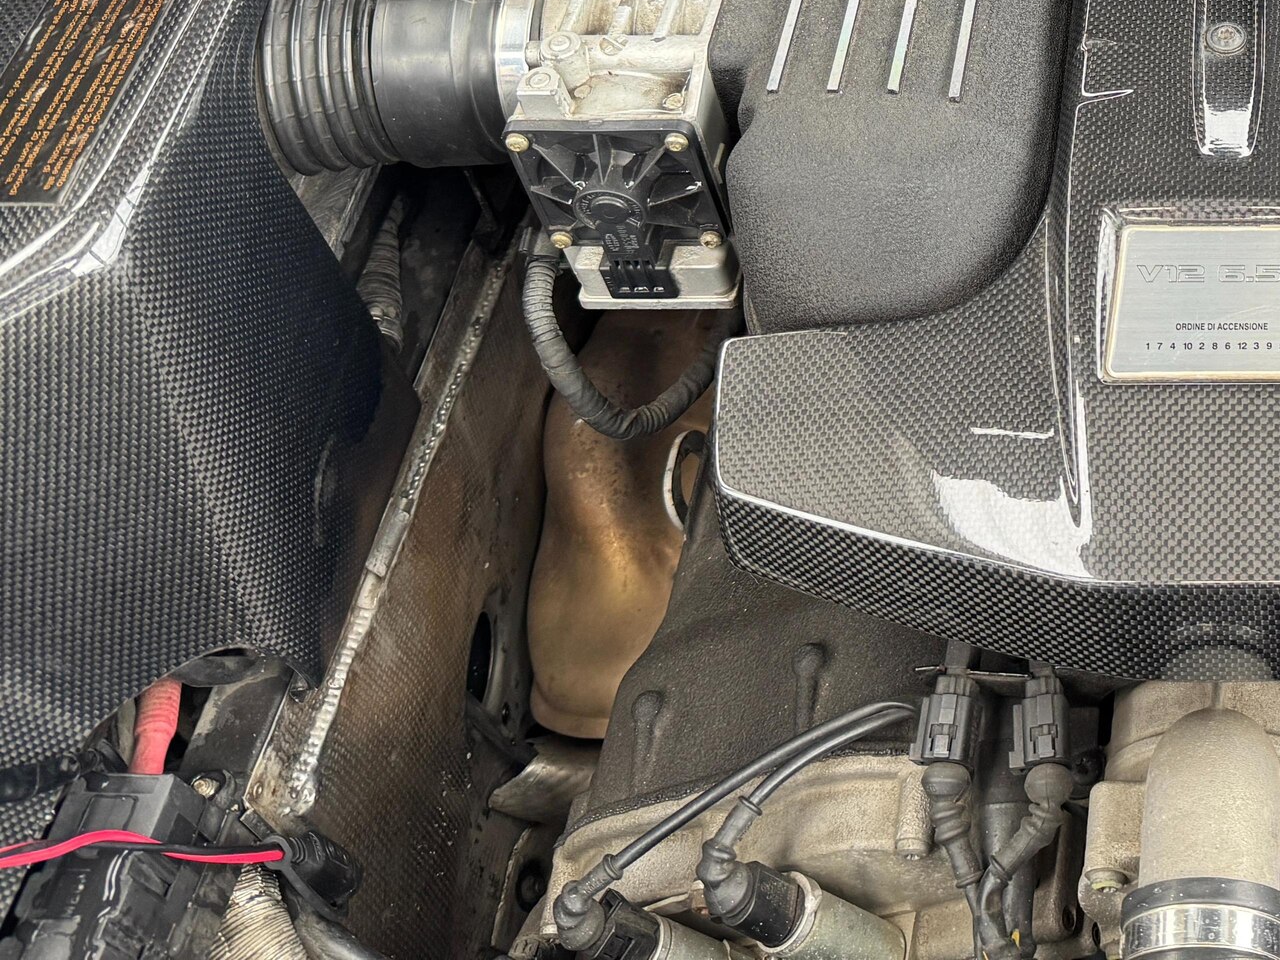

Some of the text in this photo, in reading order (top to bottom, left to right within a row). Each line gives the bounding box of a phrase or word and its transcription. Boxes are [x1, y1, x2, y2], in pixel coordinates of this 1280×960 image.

[46, 57, 66, 78] period
[117, 50, 137, 74] vettura
[81, 64, 110, 102] potrebbero
[111, 75, 124, 84] ha
[106, 86, 117, 95] un
[89, 96, 111, 124] periodo
[11, 127, 23, 135] or
[29, 131, 41, 140] 20
[1137, 264, 1206, 283] V12
[1175, 323, 1269, 331] ORDINE DI ACCENSIONE
